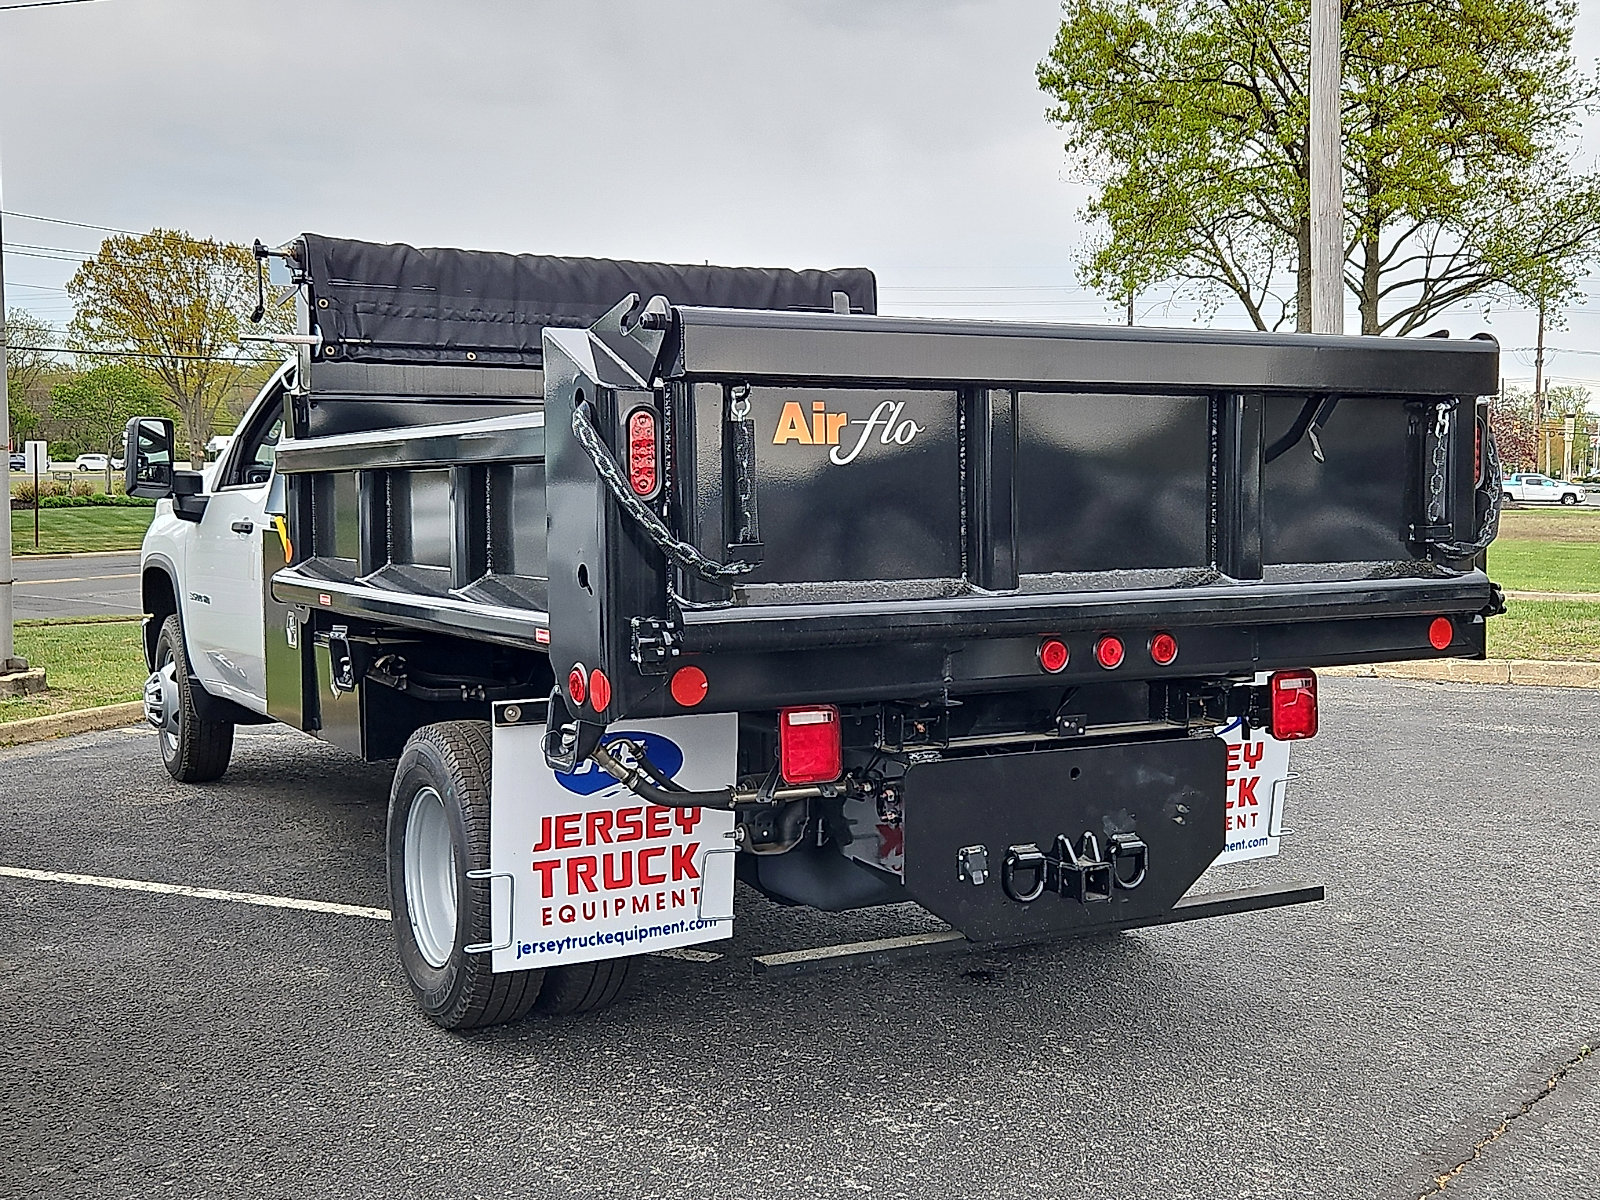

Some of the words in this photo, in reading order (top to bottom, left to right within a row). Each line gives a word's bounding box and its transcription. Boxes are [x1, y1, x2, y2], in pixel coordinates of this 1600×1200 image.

[532, 806, 702, 853] JERSEY
[532, 842, 701, 899] TRUCK
[541, 886, 701, 927] EQUIPMENT
[516, 918, 718, 960] jerseytruckequipment.com
